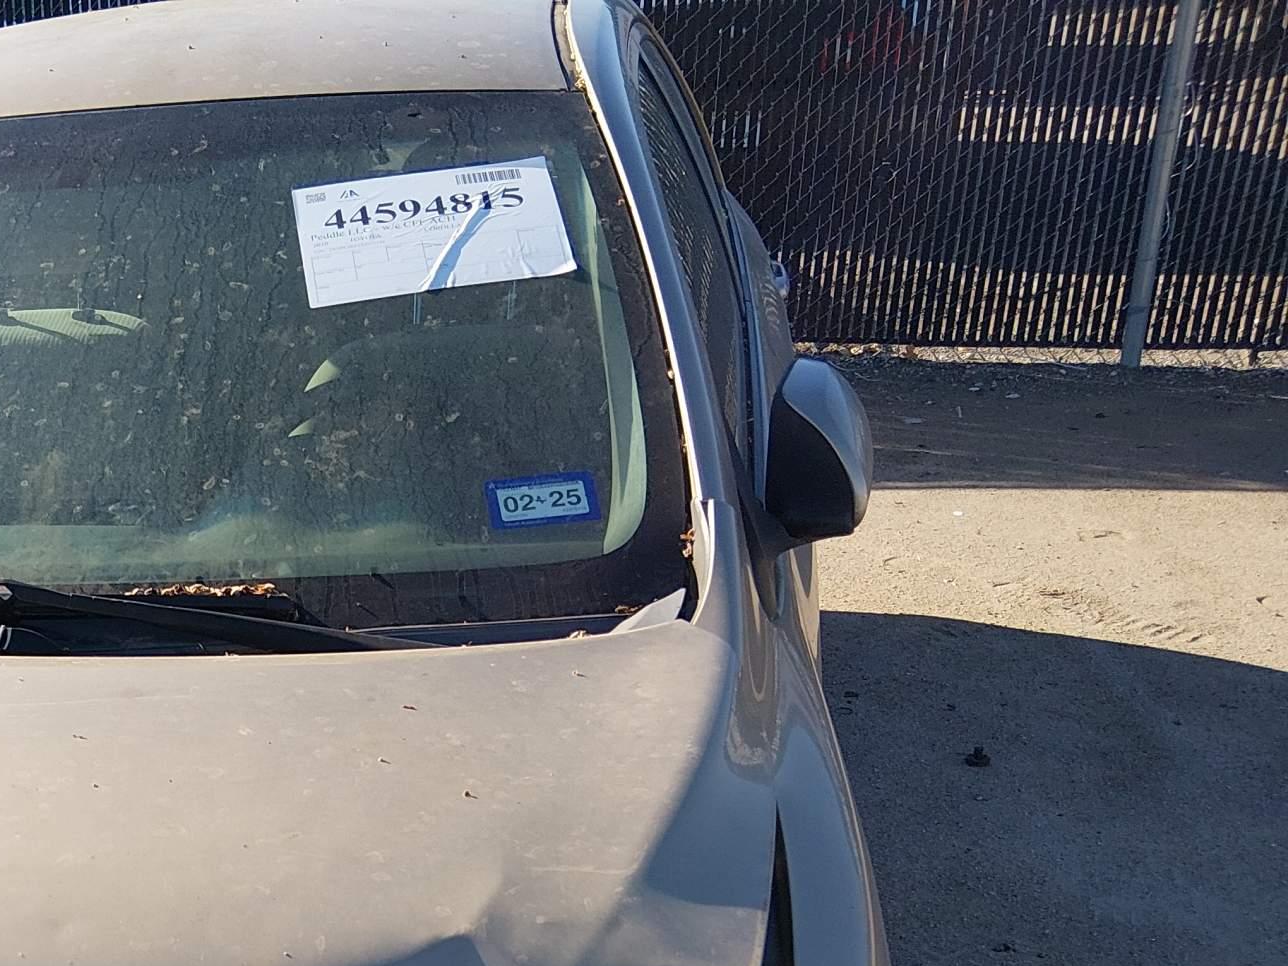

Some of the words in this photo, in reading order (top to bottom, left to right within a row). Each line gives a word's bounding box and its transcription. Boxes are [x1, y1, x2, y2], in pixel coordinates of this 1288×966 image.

[324, 187, 524, 230] 44594815
[503, 494, 536, 513] 02
[548, 488, 582, 508] 25
